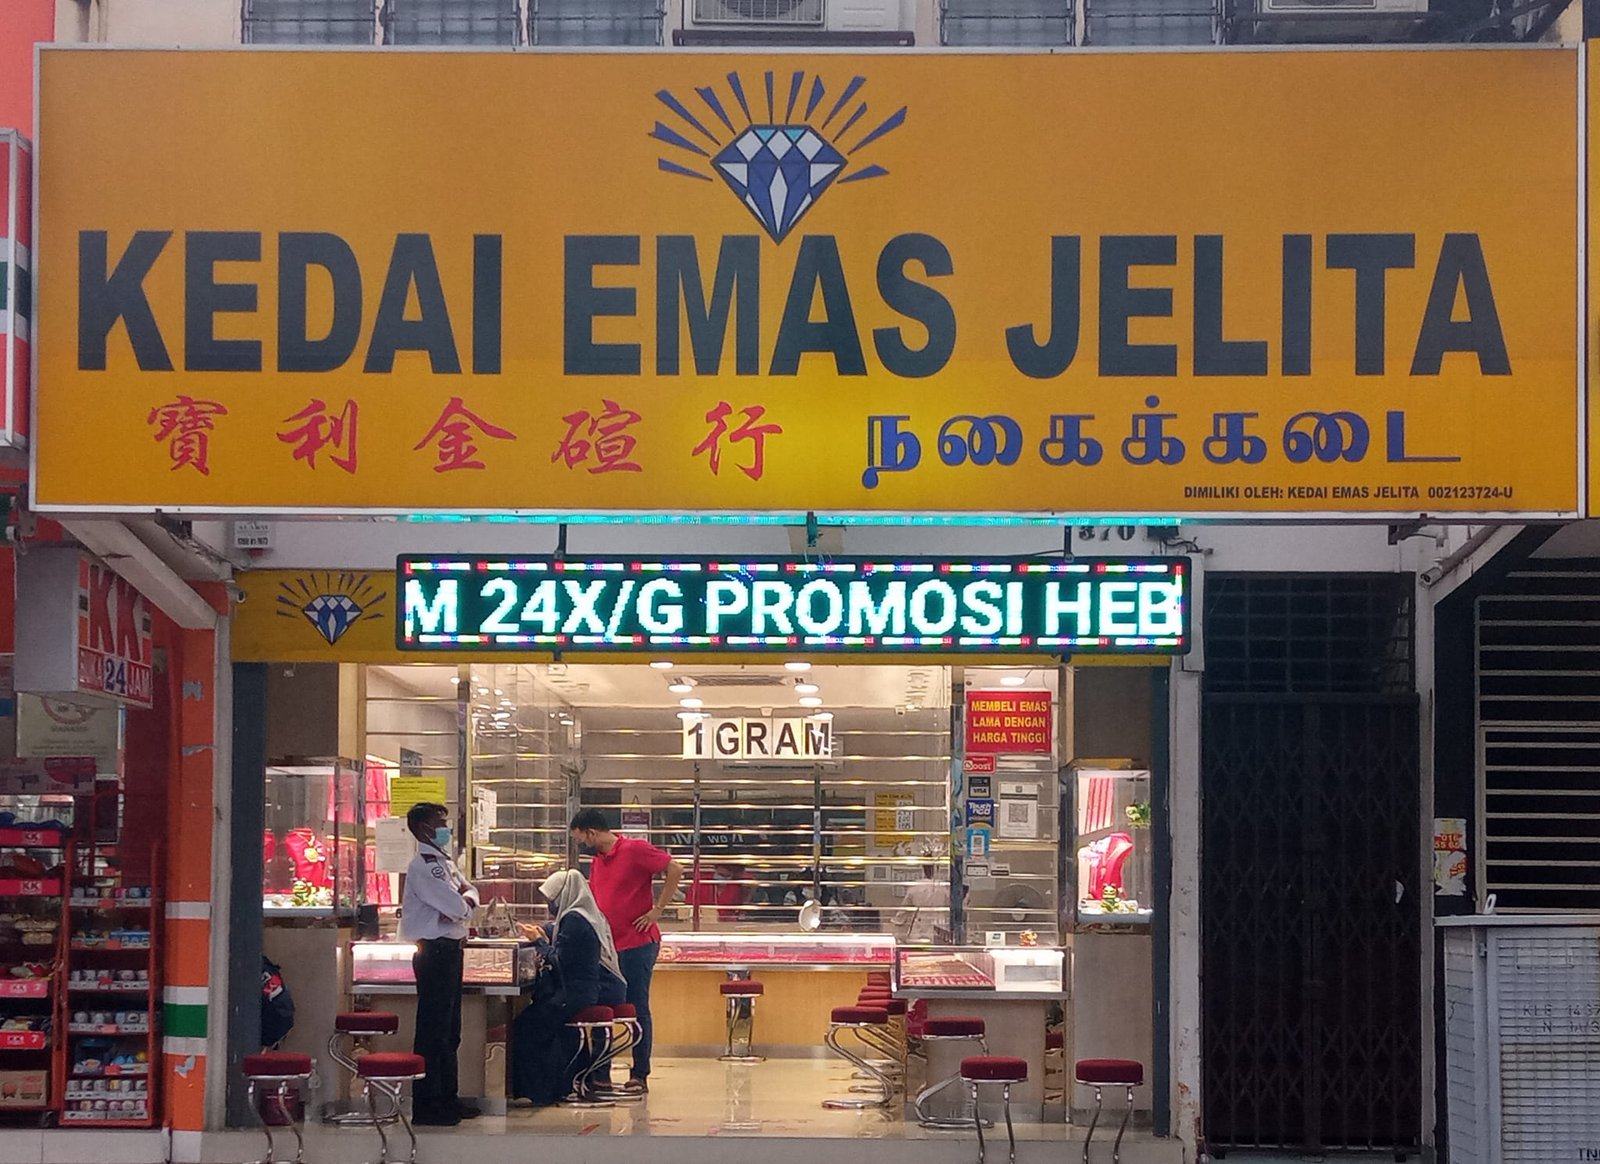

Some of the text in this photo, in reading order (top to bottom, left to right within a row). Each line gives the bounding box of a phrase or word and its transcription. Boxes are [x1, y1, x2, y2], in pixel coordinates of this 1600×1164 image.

[78, 230, 1512, 379] KEDAI EMAS JELITA
[1184, 486, 1513, 498] DIMILIKI OLEH: KEDAI EMAS JELITA 002123724-U
[705, 579, 1023, 635] PROMOSI
[105, 657, 126, 694] 24
[971, 701, 1047, 712] MEMBELI EMAS
[973, 717, 1046, 728] LAMA DENGAN
[688, 722, 829, 755] 1 GRAM
[973, 733, 1046, 743] HARGA TINGGI
[1576, 1147, 1600, 1161] TN
